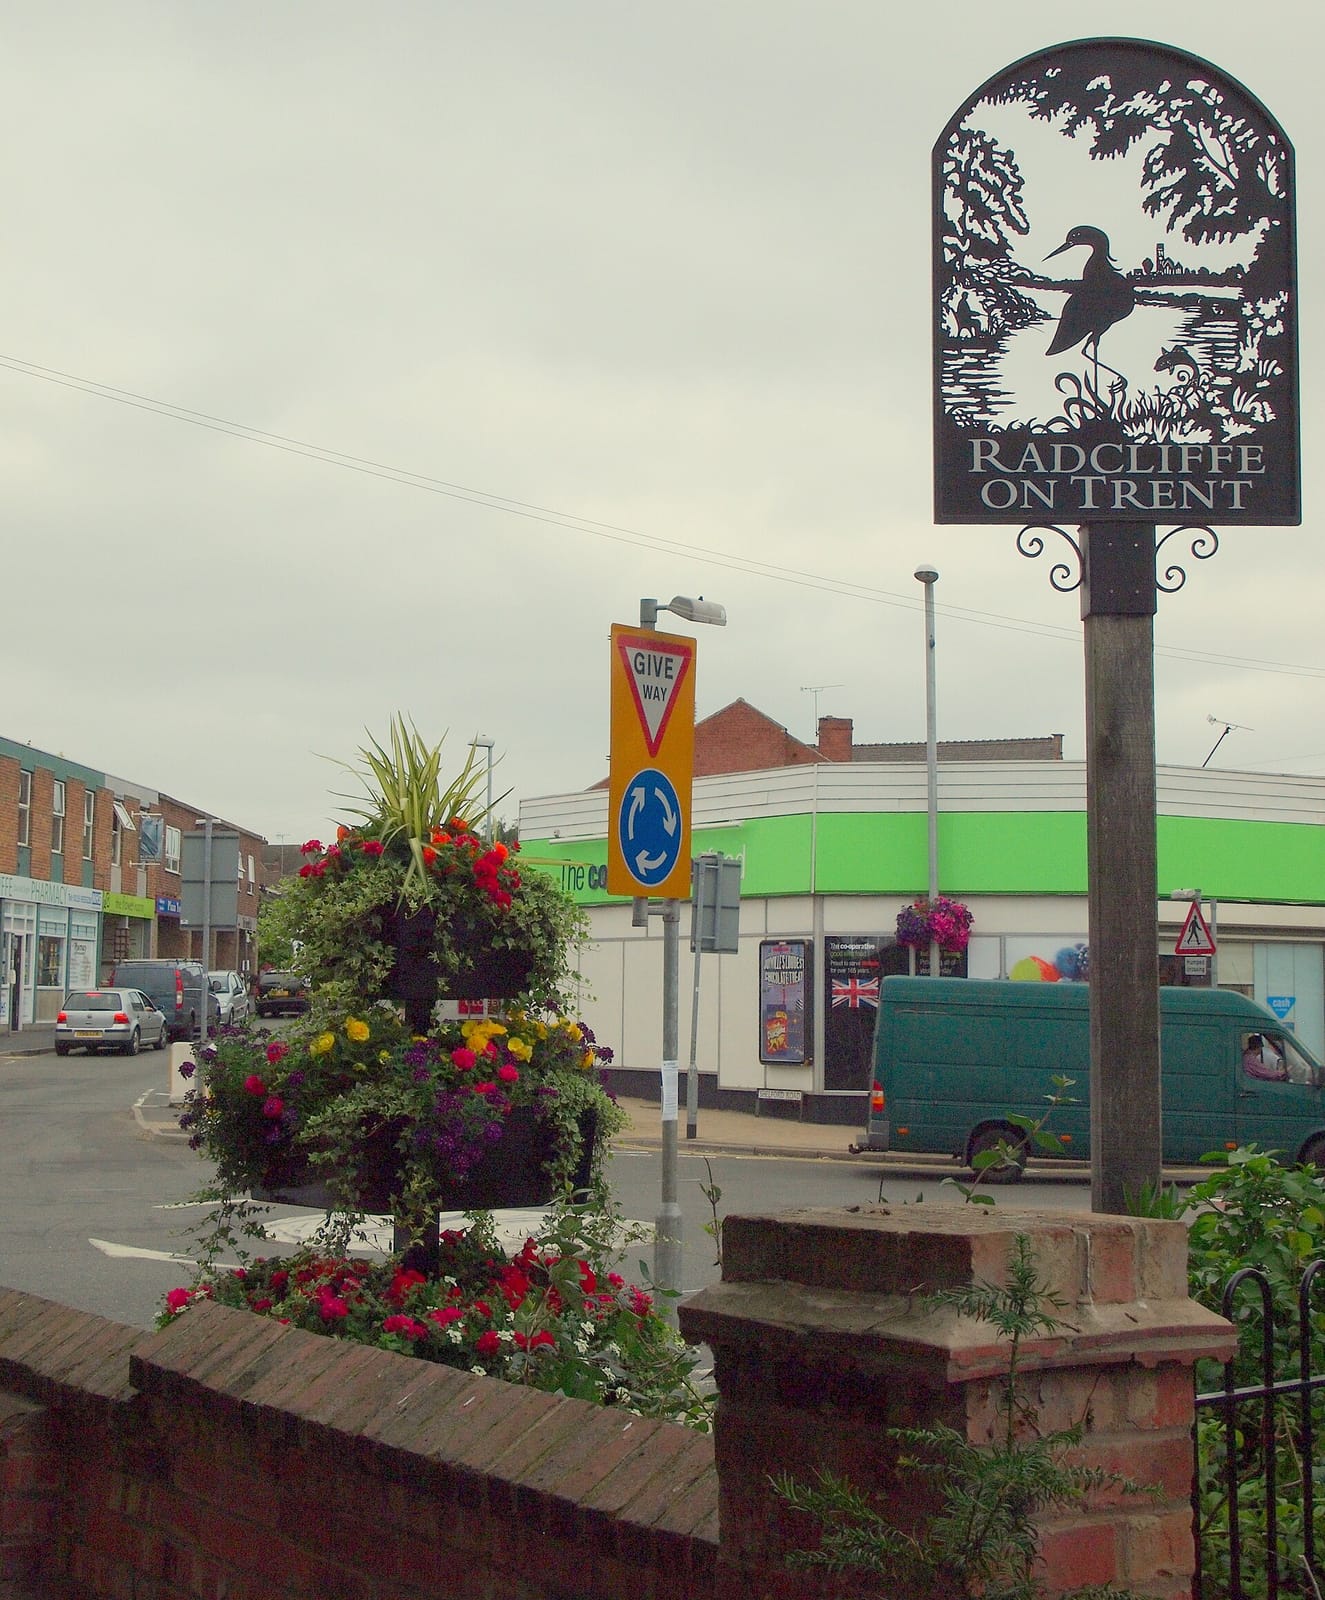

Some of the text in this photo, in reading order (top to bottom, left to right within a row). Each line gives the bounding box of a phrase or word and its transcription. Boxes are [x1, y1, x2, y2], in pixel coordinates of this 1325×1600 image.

[968, 439, 1266, 475] RADCLIFFE
[981, 475, 1253, 510] ON TRENT
[633, 652, 674, 680] GIVE
[642, 683, 668, 701] WAY
[31, 880, 68, 905] PHARMACY
[840, 943, 876, 951] co-operative
